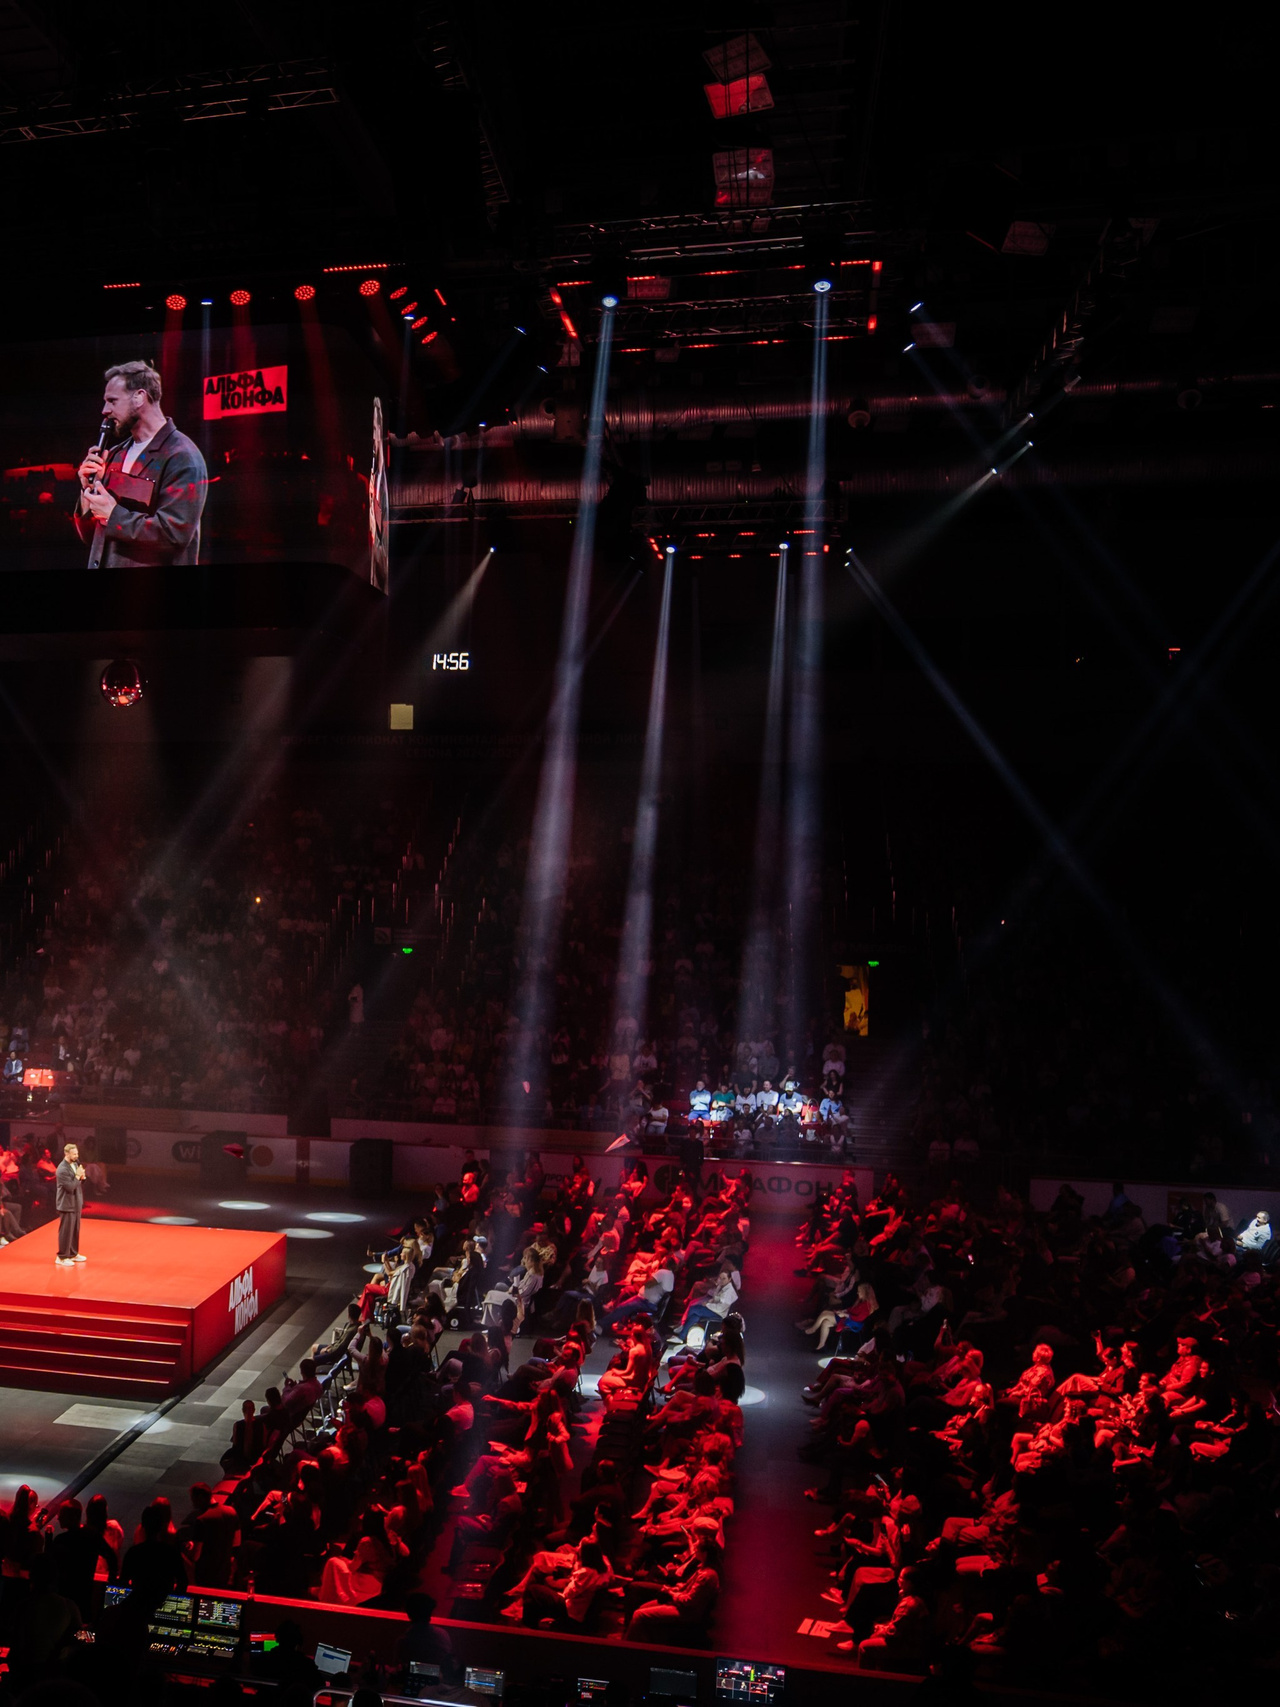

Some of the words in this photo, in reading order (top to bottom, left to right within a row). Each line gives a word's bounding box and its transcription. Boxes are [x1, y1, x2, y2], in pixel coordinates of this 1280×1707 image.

[205, 371, 265, 395] АЛЬФА
[221, 386, 284, 410] КОНФА
[433, 653, 469, 670] 14:56
[697, 1172, 835, 1199] МАФОН
